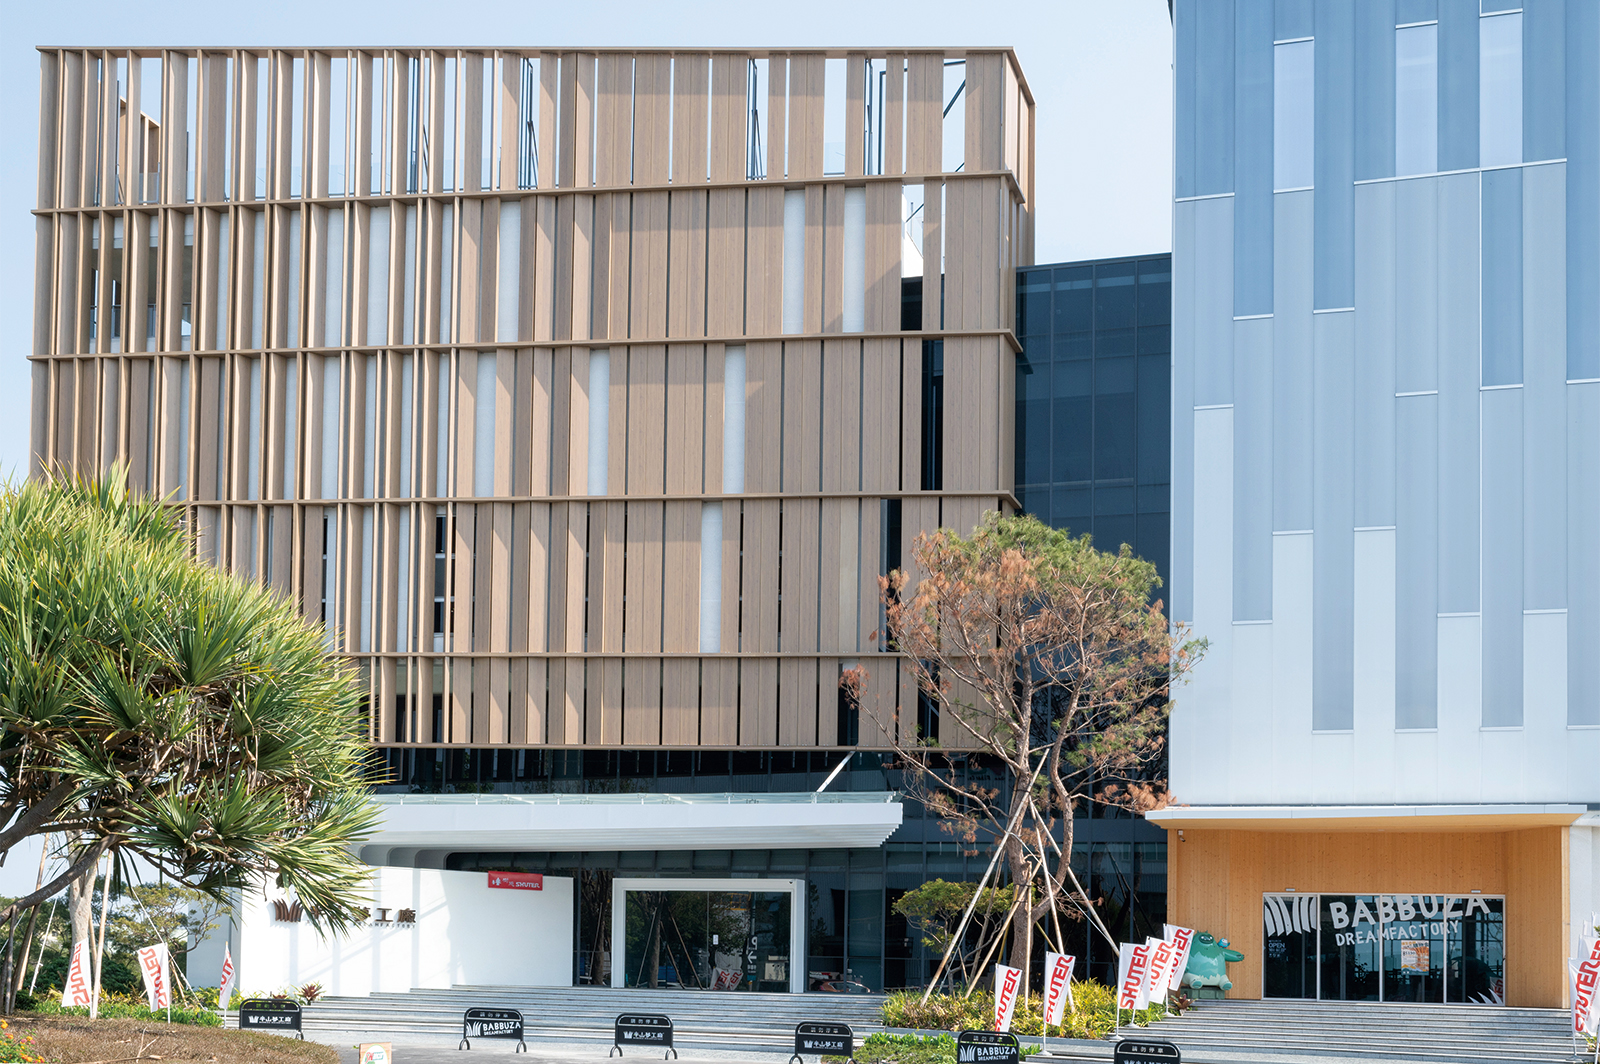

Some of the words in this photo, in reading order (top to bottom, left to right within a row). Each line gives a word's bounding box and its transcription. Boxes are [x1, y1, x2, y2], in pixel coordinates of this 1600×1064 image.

[515, 881, 541, 889] SHUTER
[1329, 895, 1491, 929] BABBUZA
[1335, 920, 1459, 947] DREAMFACTORY
[1119, 945, 1150, 1010] SHUTER
[1149, 941, 1176, 992] UTER
[1045, 956, 1074, 1024] SHUTER
[482, 1021, 521, 1031] BABBUZA
[977, 1046, 1017, 1056] BABBUZA
